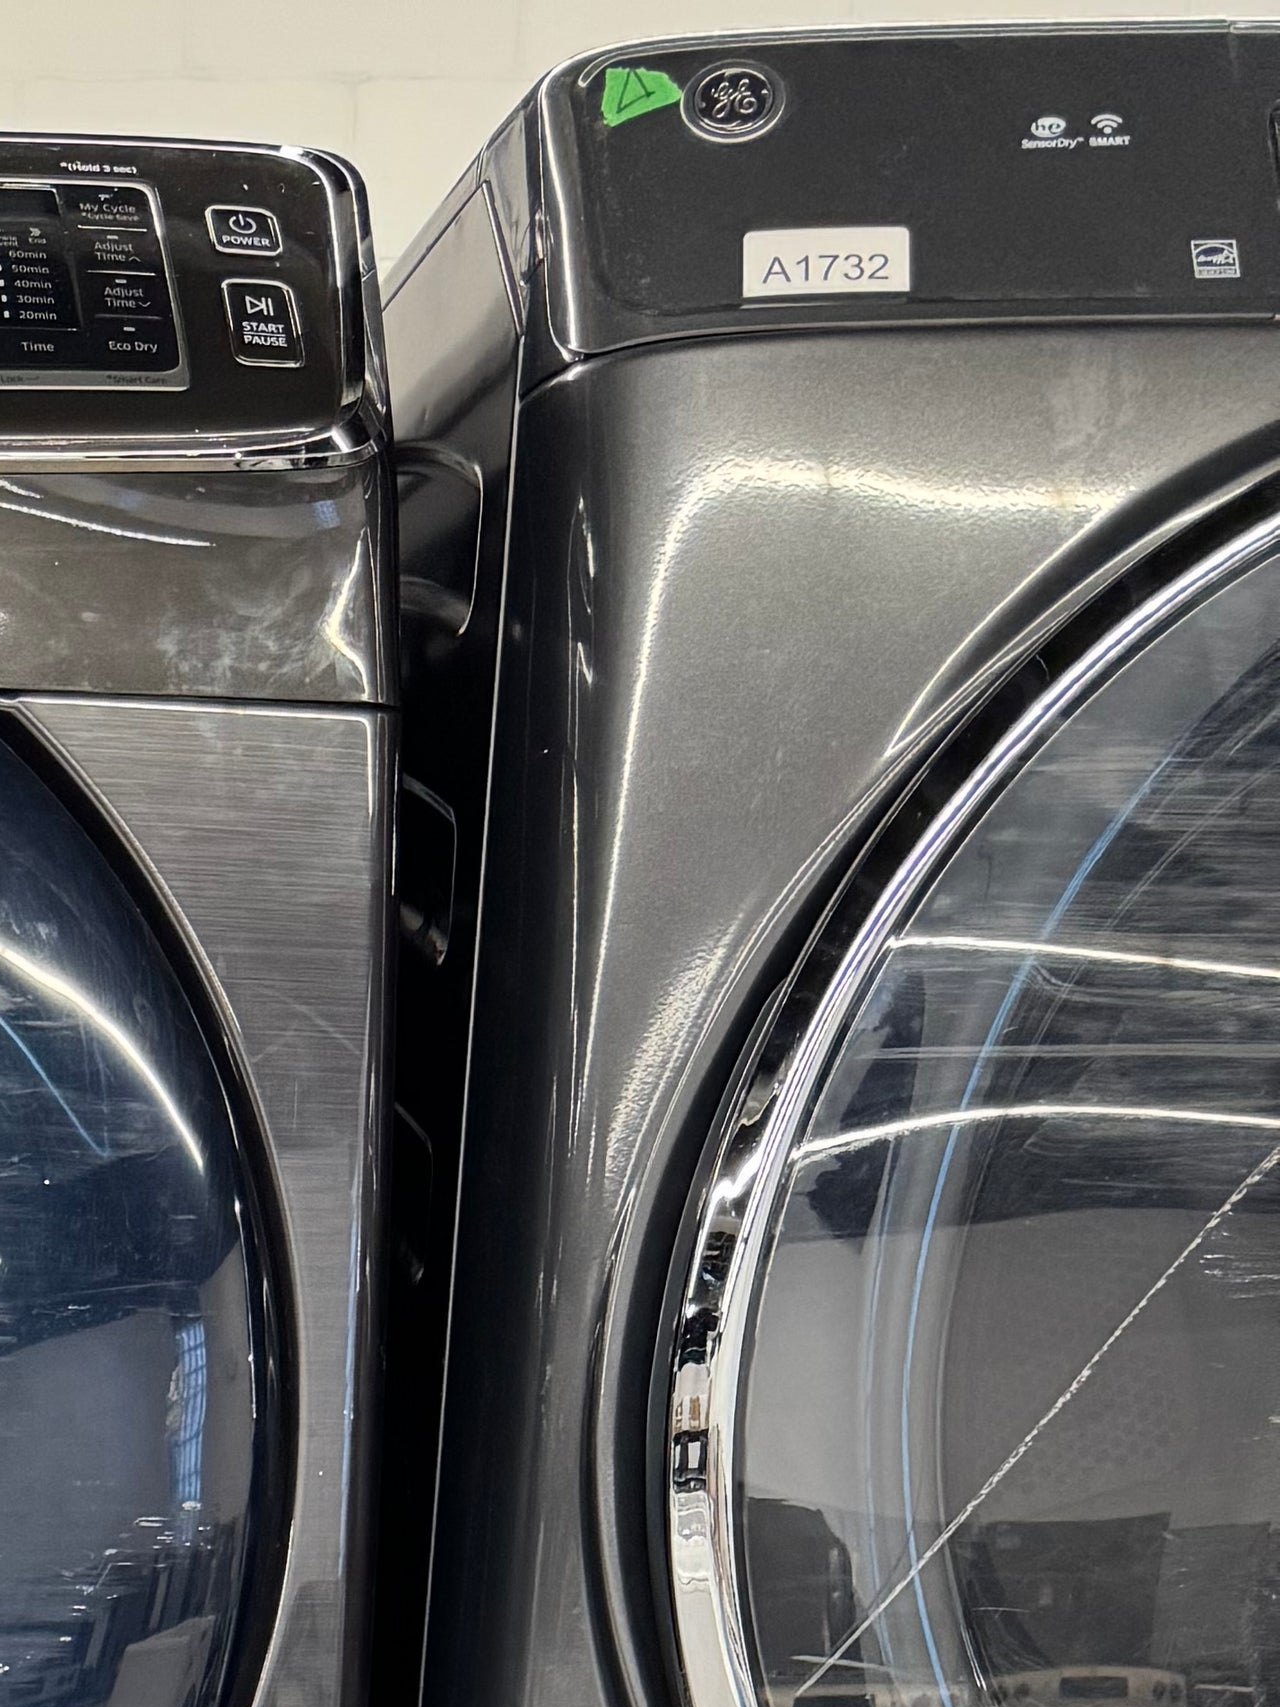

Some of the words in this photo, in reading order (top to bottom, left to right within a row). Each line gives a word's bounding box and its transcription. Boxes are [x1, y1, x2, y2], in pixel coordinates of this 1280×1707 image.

[1089, 136, 1130, 146] SMART
[223, 235, 270, 247] POWER
[762, 254, 888, 283] A1732
[242, 322, 285, 333] START
[244, 335, 287, 347] PAUSE
[22, 342, 54, 352] Time
